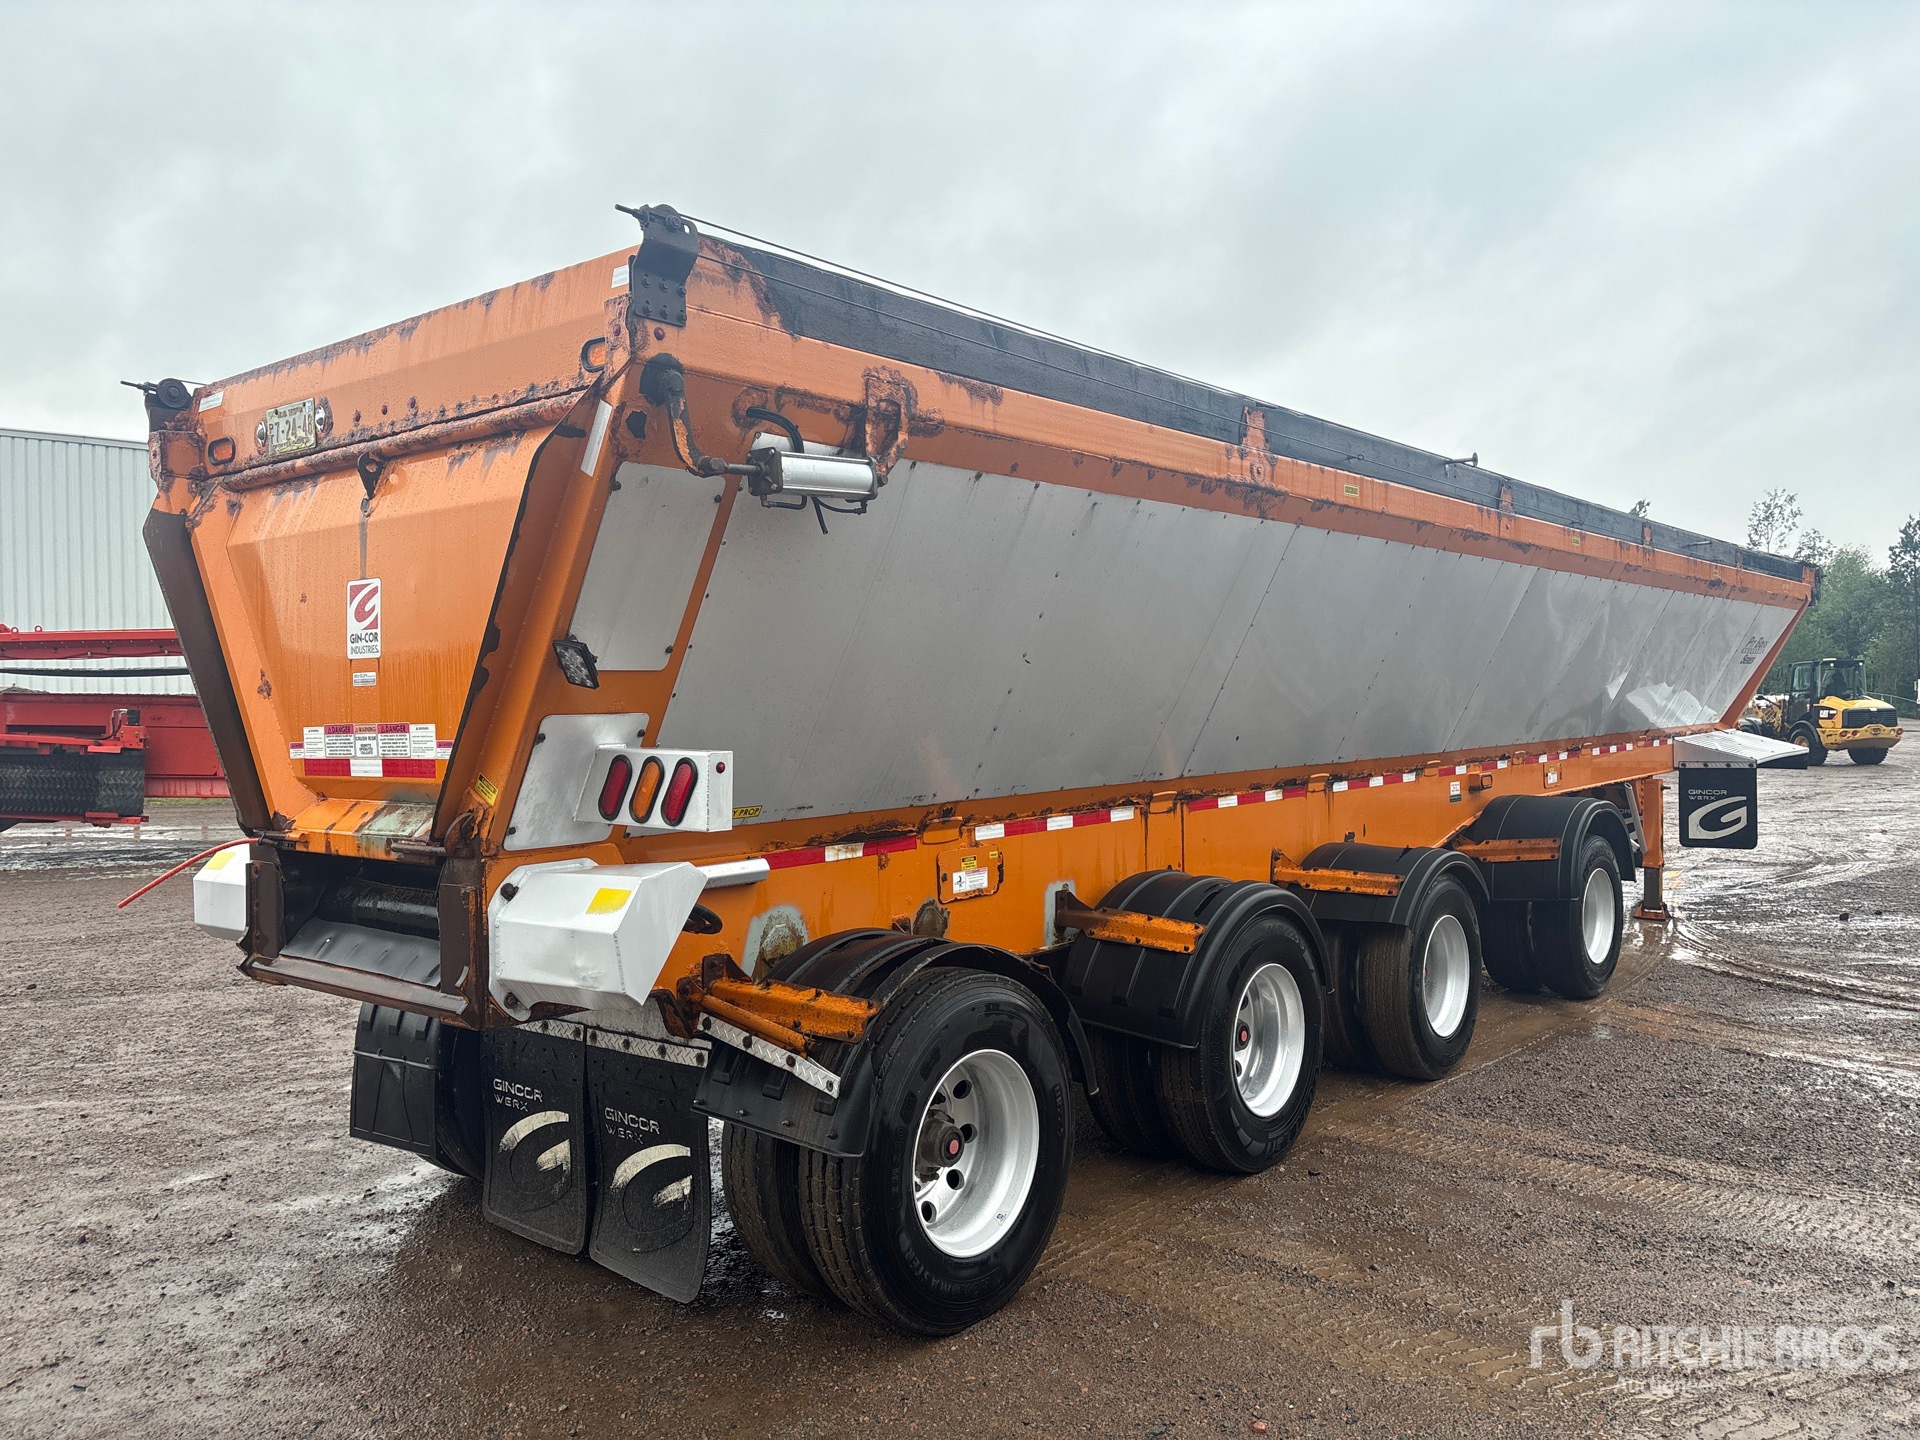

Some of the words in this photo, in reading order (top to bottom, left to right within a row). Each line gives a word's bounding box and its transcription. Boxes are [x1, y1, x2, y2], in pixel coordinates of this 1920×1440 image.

[350, 632, 379, 644] GIN-COR
[1820, 710, 1829, 718] CAT
[332, 725, 351, 733] DANGER
[386, 724, 406, 733] DANGER
[740, 808, 759, 816] PROP
[493, 1078, 543, 1103] GINCOR
[493, 1093, 529, 1112] WERX
[604, 1107, 660, 1135] GINCOR
[605, 1124, 644, 1145] WERX
